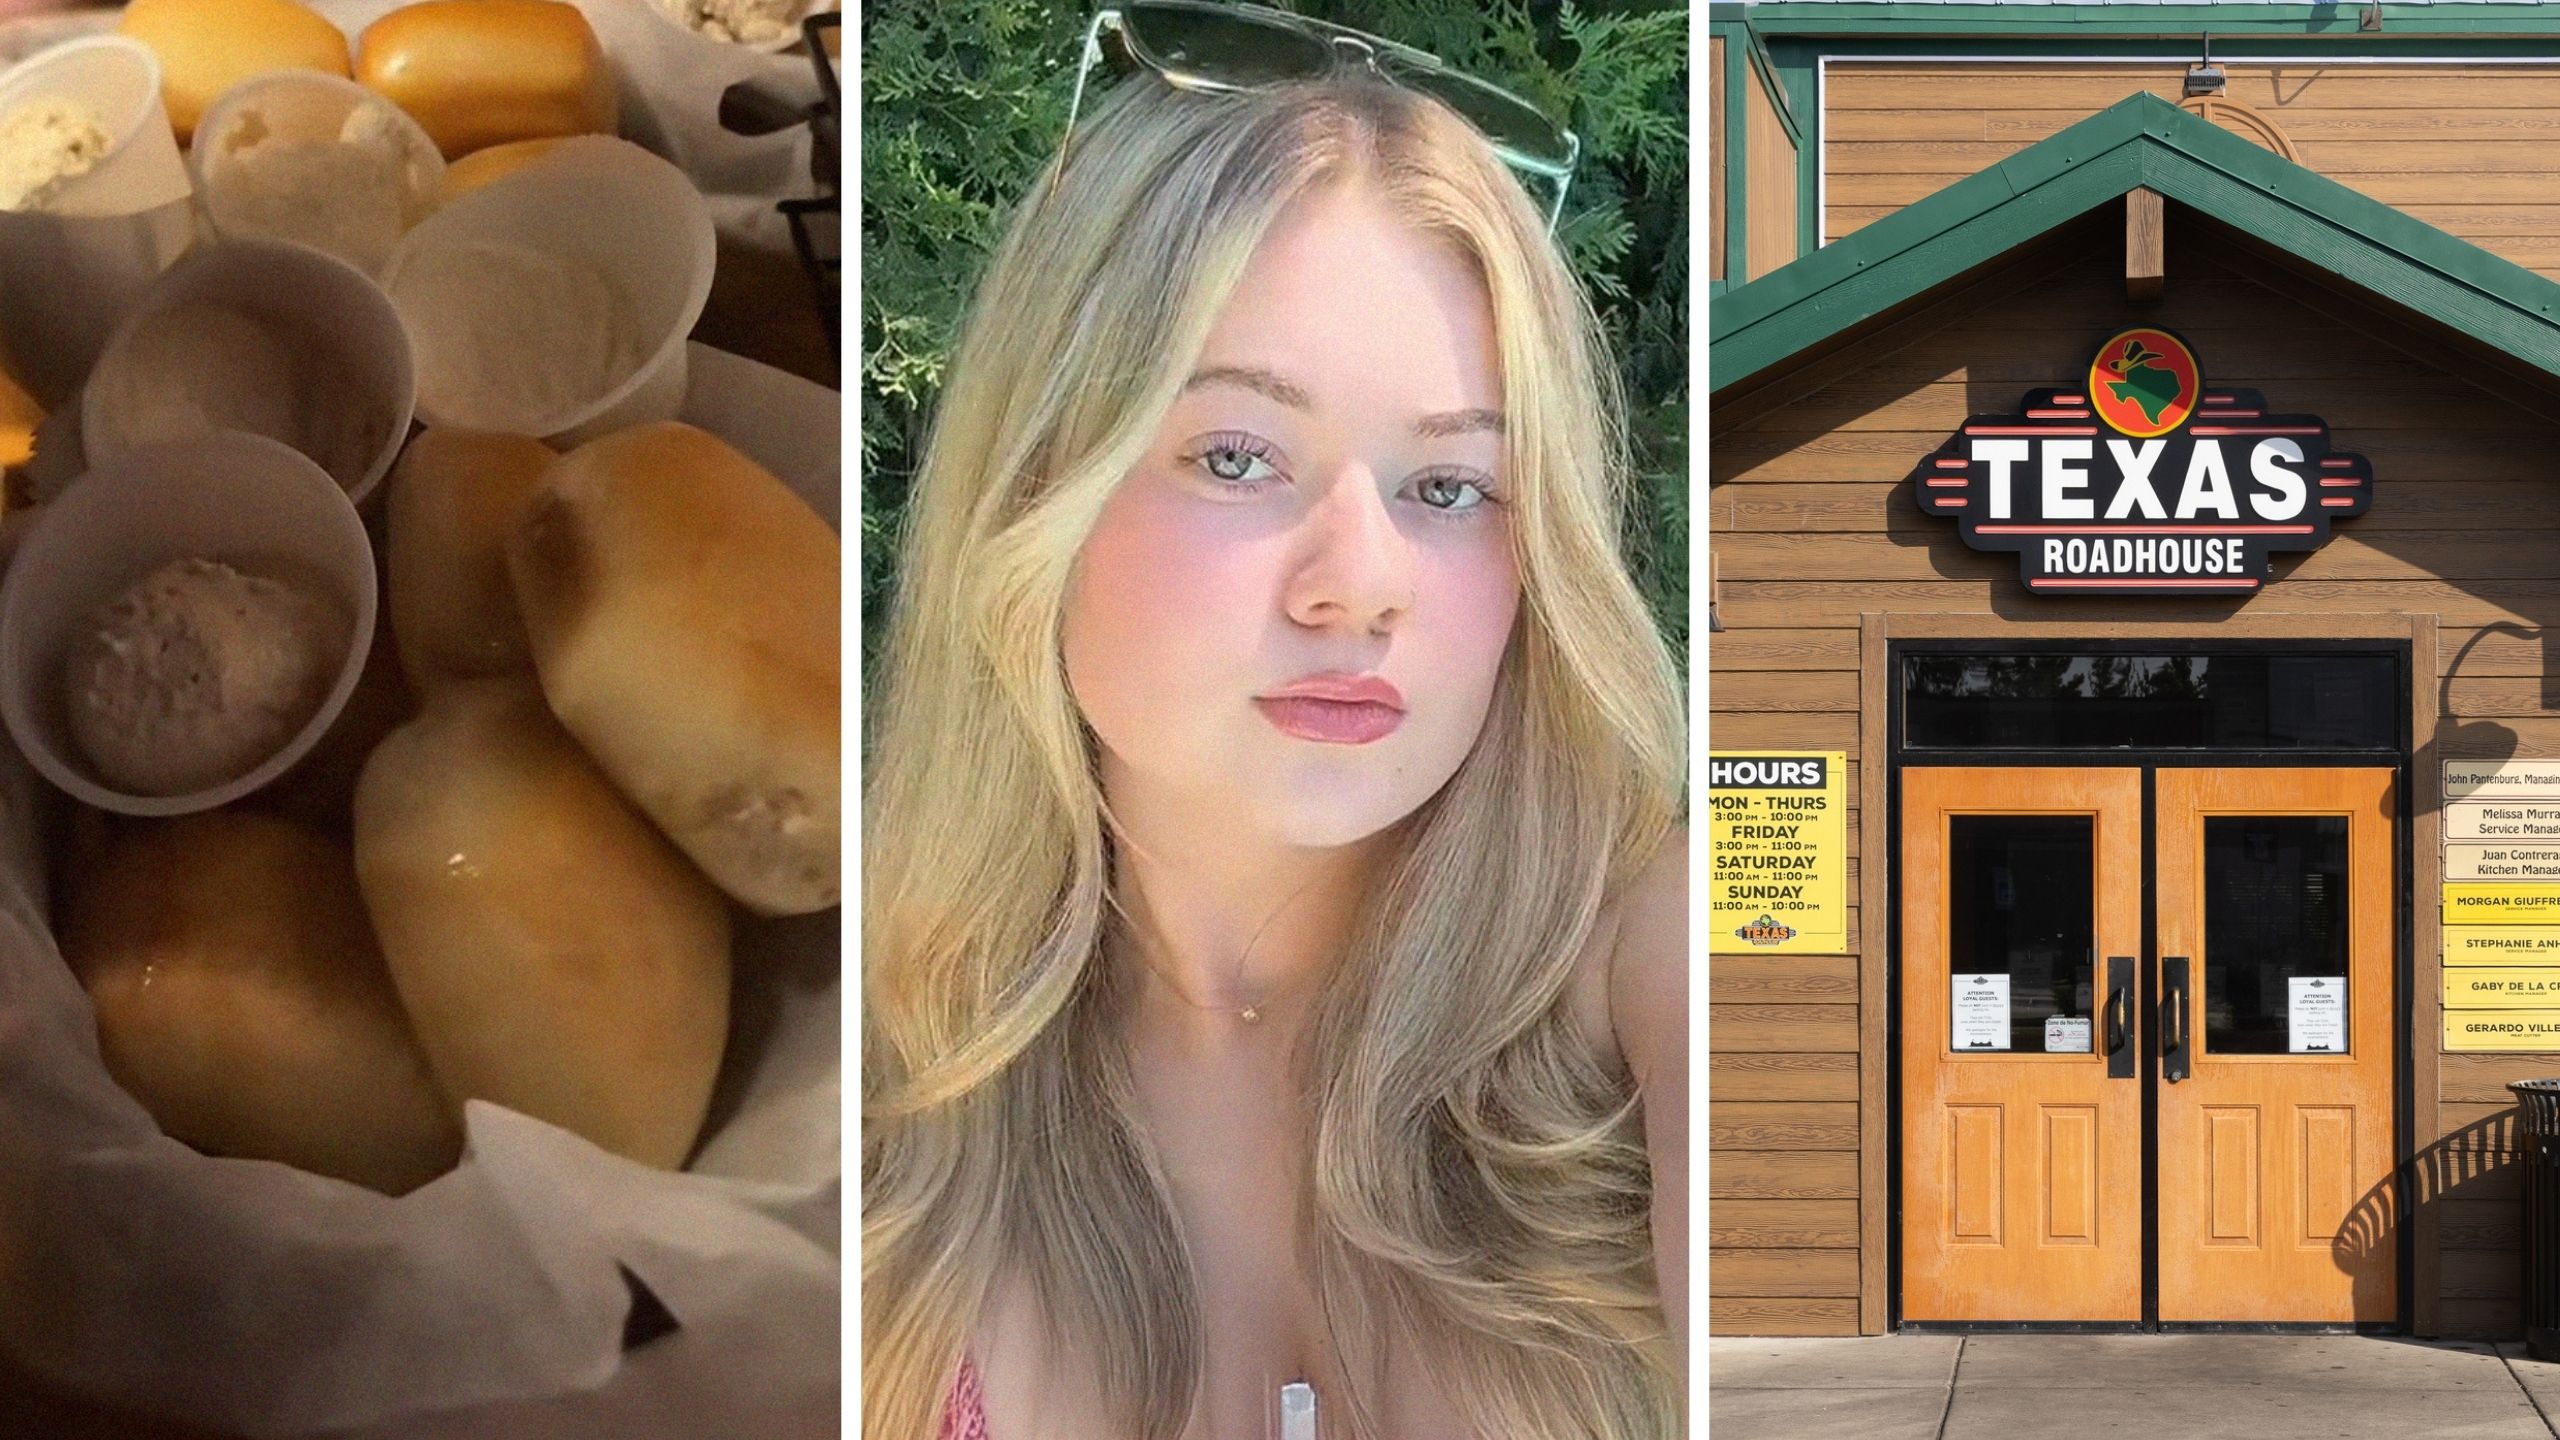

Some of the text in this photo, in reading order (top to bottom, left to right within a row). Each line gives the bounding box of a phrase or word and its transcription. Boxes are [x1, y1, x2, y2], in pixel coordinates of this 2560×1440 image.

[1971, 437, 2308, 521] TEXAS
[2043, 538, 2244, 574] ROADHOUSE
[1711, 761, 1821, 785] HOURS
[2448, 773, 2468, 784] John
[1709, 796, 1748, 809] MON
[1765, 796, 1827, 810] THURS
[1715, 812, 1742, 821] 3:00
[1770, 812, 1803, 821] 10:00
[2482, 809, 2523, 819] Melissa
[1732, 825, 1799, 839] FRIDAY
[2479, 824, 2520, 834] Service
[1716, 841, 1742, 851] 3:00
[1772, 841, 1802, 851] 11:00
[2482, 850, 2507, 860] Juan
[1716, 856, 1816, 869] SATURDAY
[2477, 865, 2518, 875] Kitchen
[1713, 872, 1744, 880] 11:00
[1772, 872, 1802, 880] 11:00
[1728, 885, 1803, 899] SUNDAY
[1713, 901, 1743, 910] 11:00
[1771, 901, 1804, 910] 10:00
[2457, 897, 2510, 906] MORGAN
[1743, 926, 1788, 939] TEXAS
[2466, 939, 2533, 948] STEPHANIE
[2471, 982, 2504, 990] GABY
[2509, 982, 2524, 990] DE
[2528, 982, 2545, 990] LA
[2466, 1024, 2524, 1032] GERARDO
